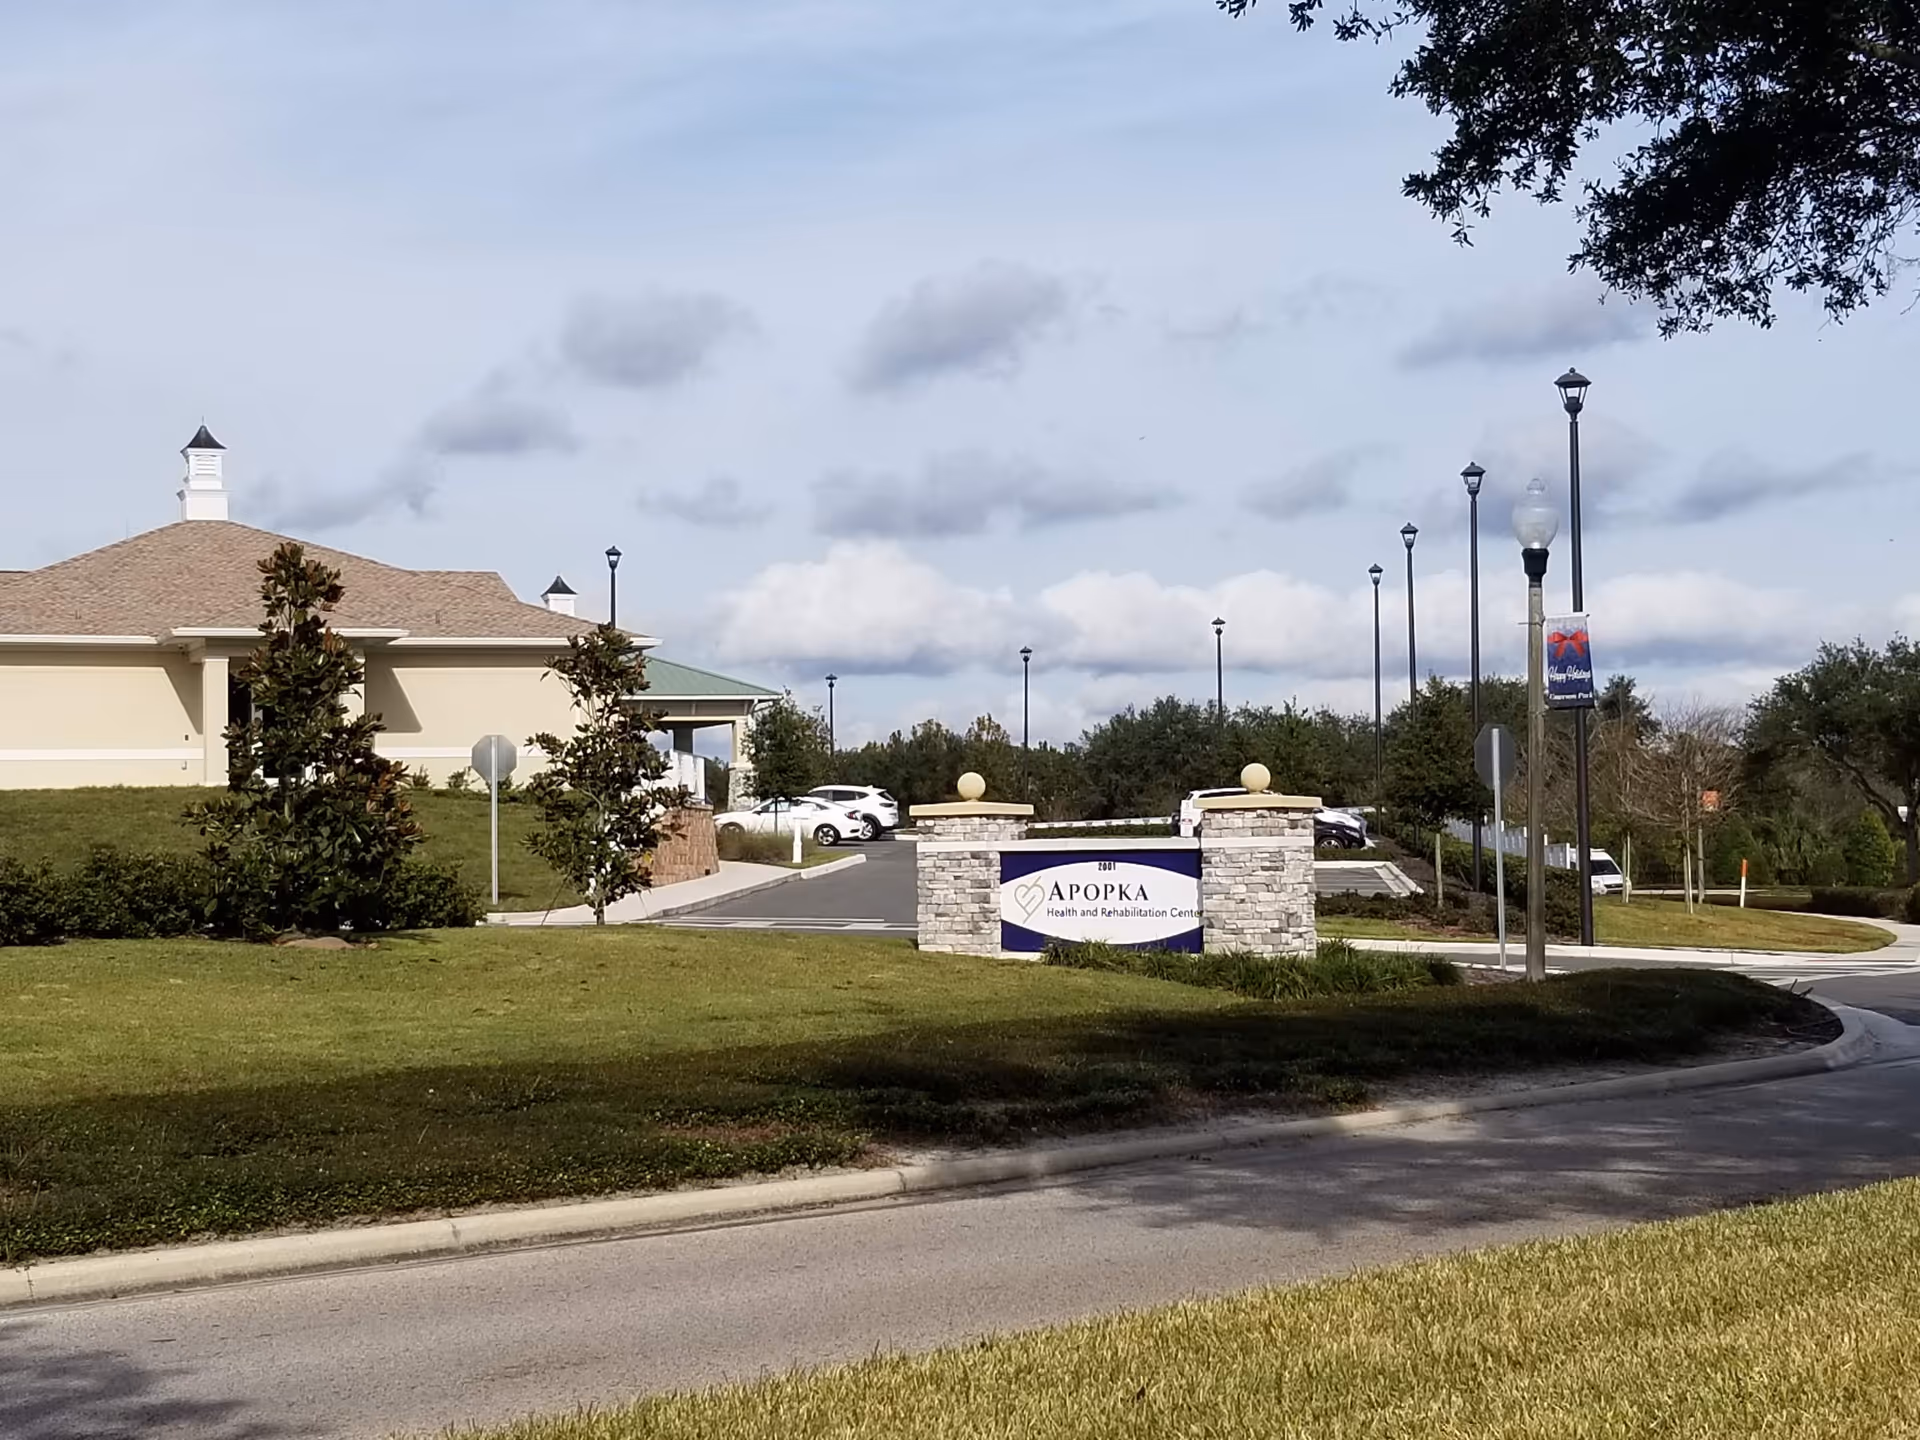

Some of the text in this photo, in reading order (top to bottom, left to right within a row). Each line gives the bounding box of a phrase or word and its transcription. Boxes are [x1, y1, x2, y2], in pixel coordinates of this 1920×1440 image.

[1098, 862, 1116, 871] 2001
[1048, 880, 1149, 901] APOPKA
[1047, 906, 1078, 917] Health
[1080, 907, 1098, 917] and
[1101, 907, 1167, 918] Rehabilitation
